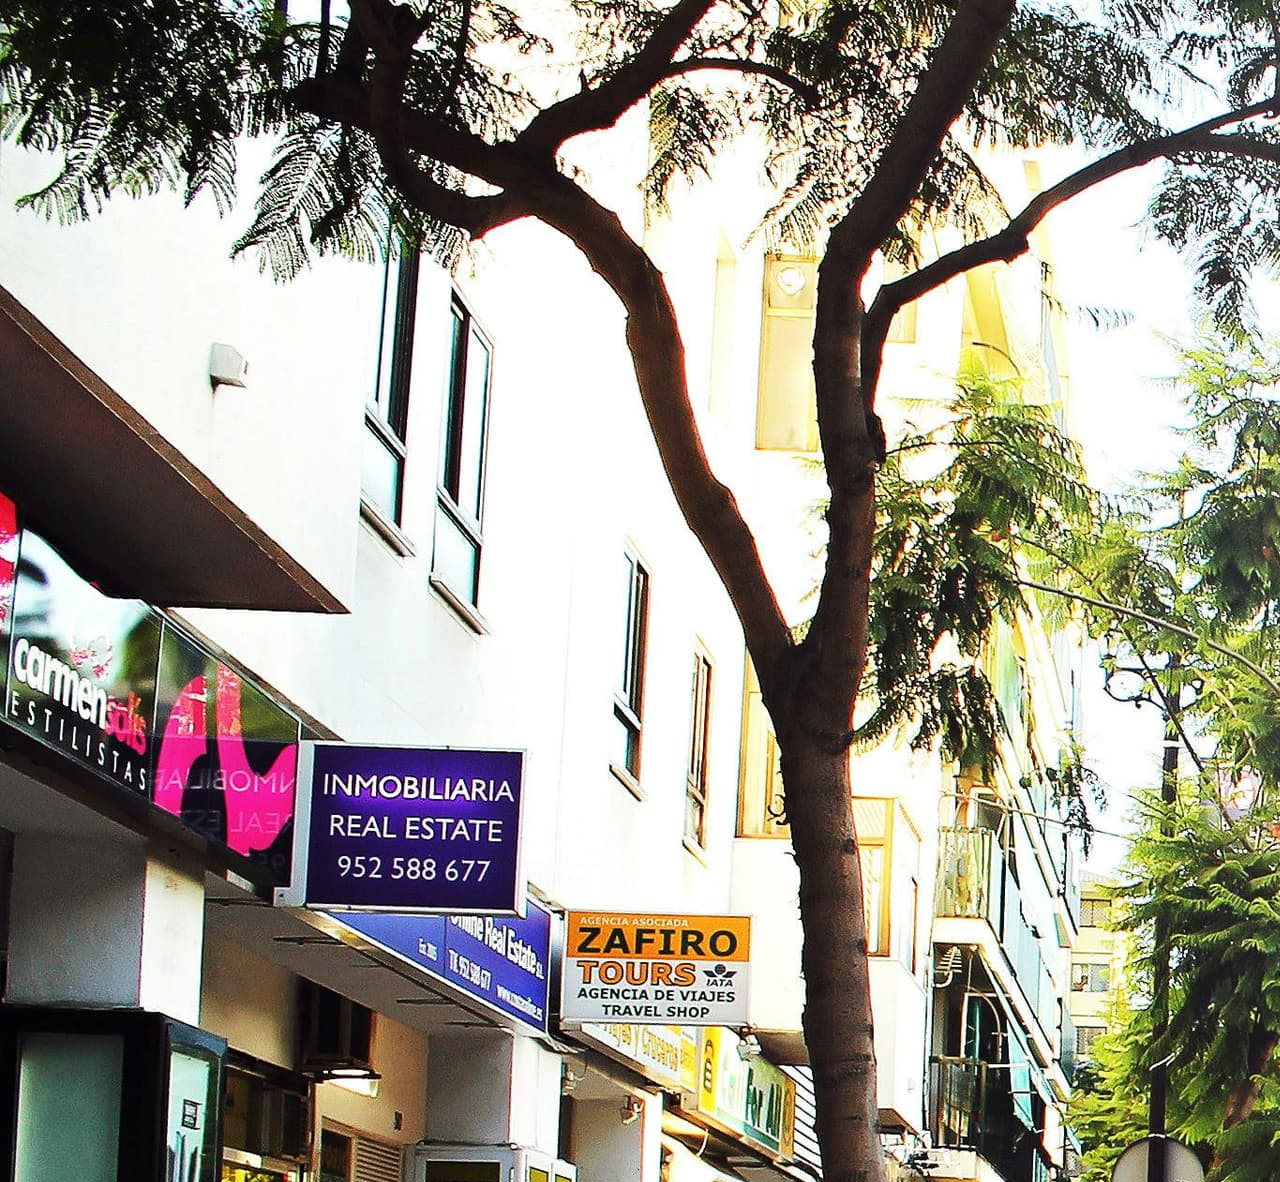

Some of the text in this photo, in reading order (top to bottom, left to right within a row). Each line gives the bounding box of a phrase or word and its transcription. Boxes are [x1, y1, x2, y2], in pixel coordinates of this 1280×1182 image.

[12, 638, 107, 730] carmen
[11, 691, 147, 791] ESTILISTAS
[323, 773, 515, 802] INMOBILIARIA
[329, 814, 503, 842] REAL ESTATE
[337, 855, 491, 883] 952 588 677
[580, 916, 689, 927] AGENCIA ASOCIADA
[485, 916, 507, 956] Real
[507, 929, 537, 973] Estate
[577, 926, 738, 957] ZAFIRO
[576, 960, 697, 987] TOURS
[706, 978, 734, 987] IATA
[577, 987, 736, 1003] AGENCIA DE VIAJES
[602, 1004, 710, 1018] TRAVEL SHOP
